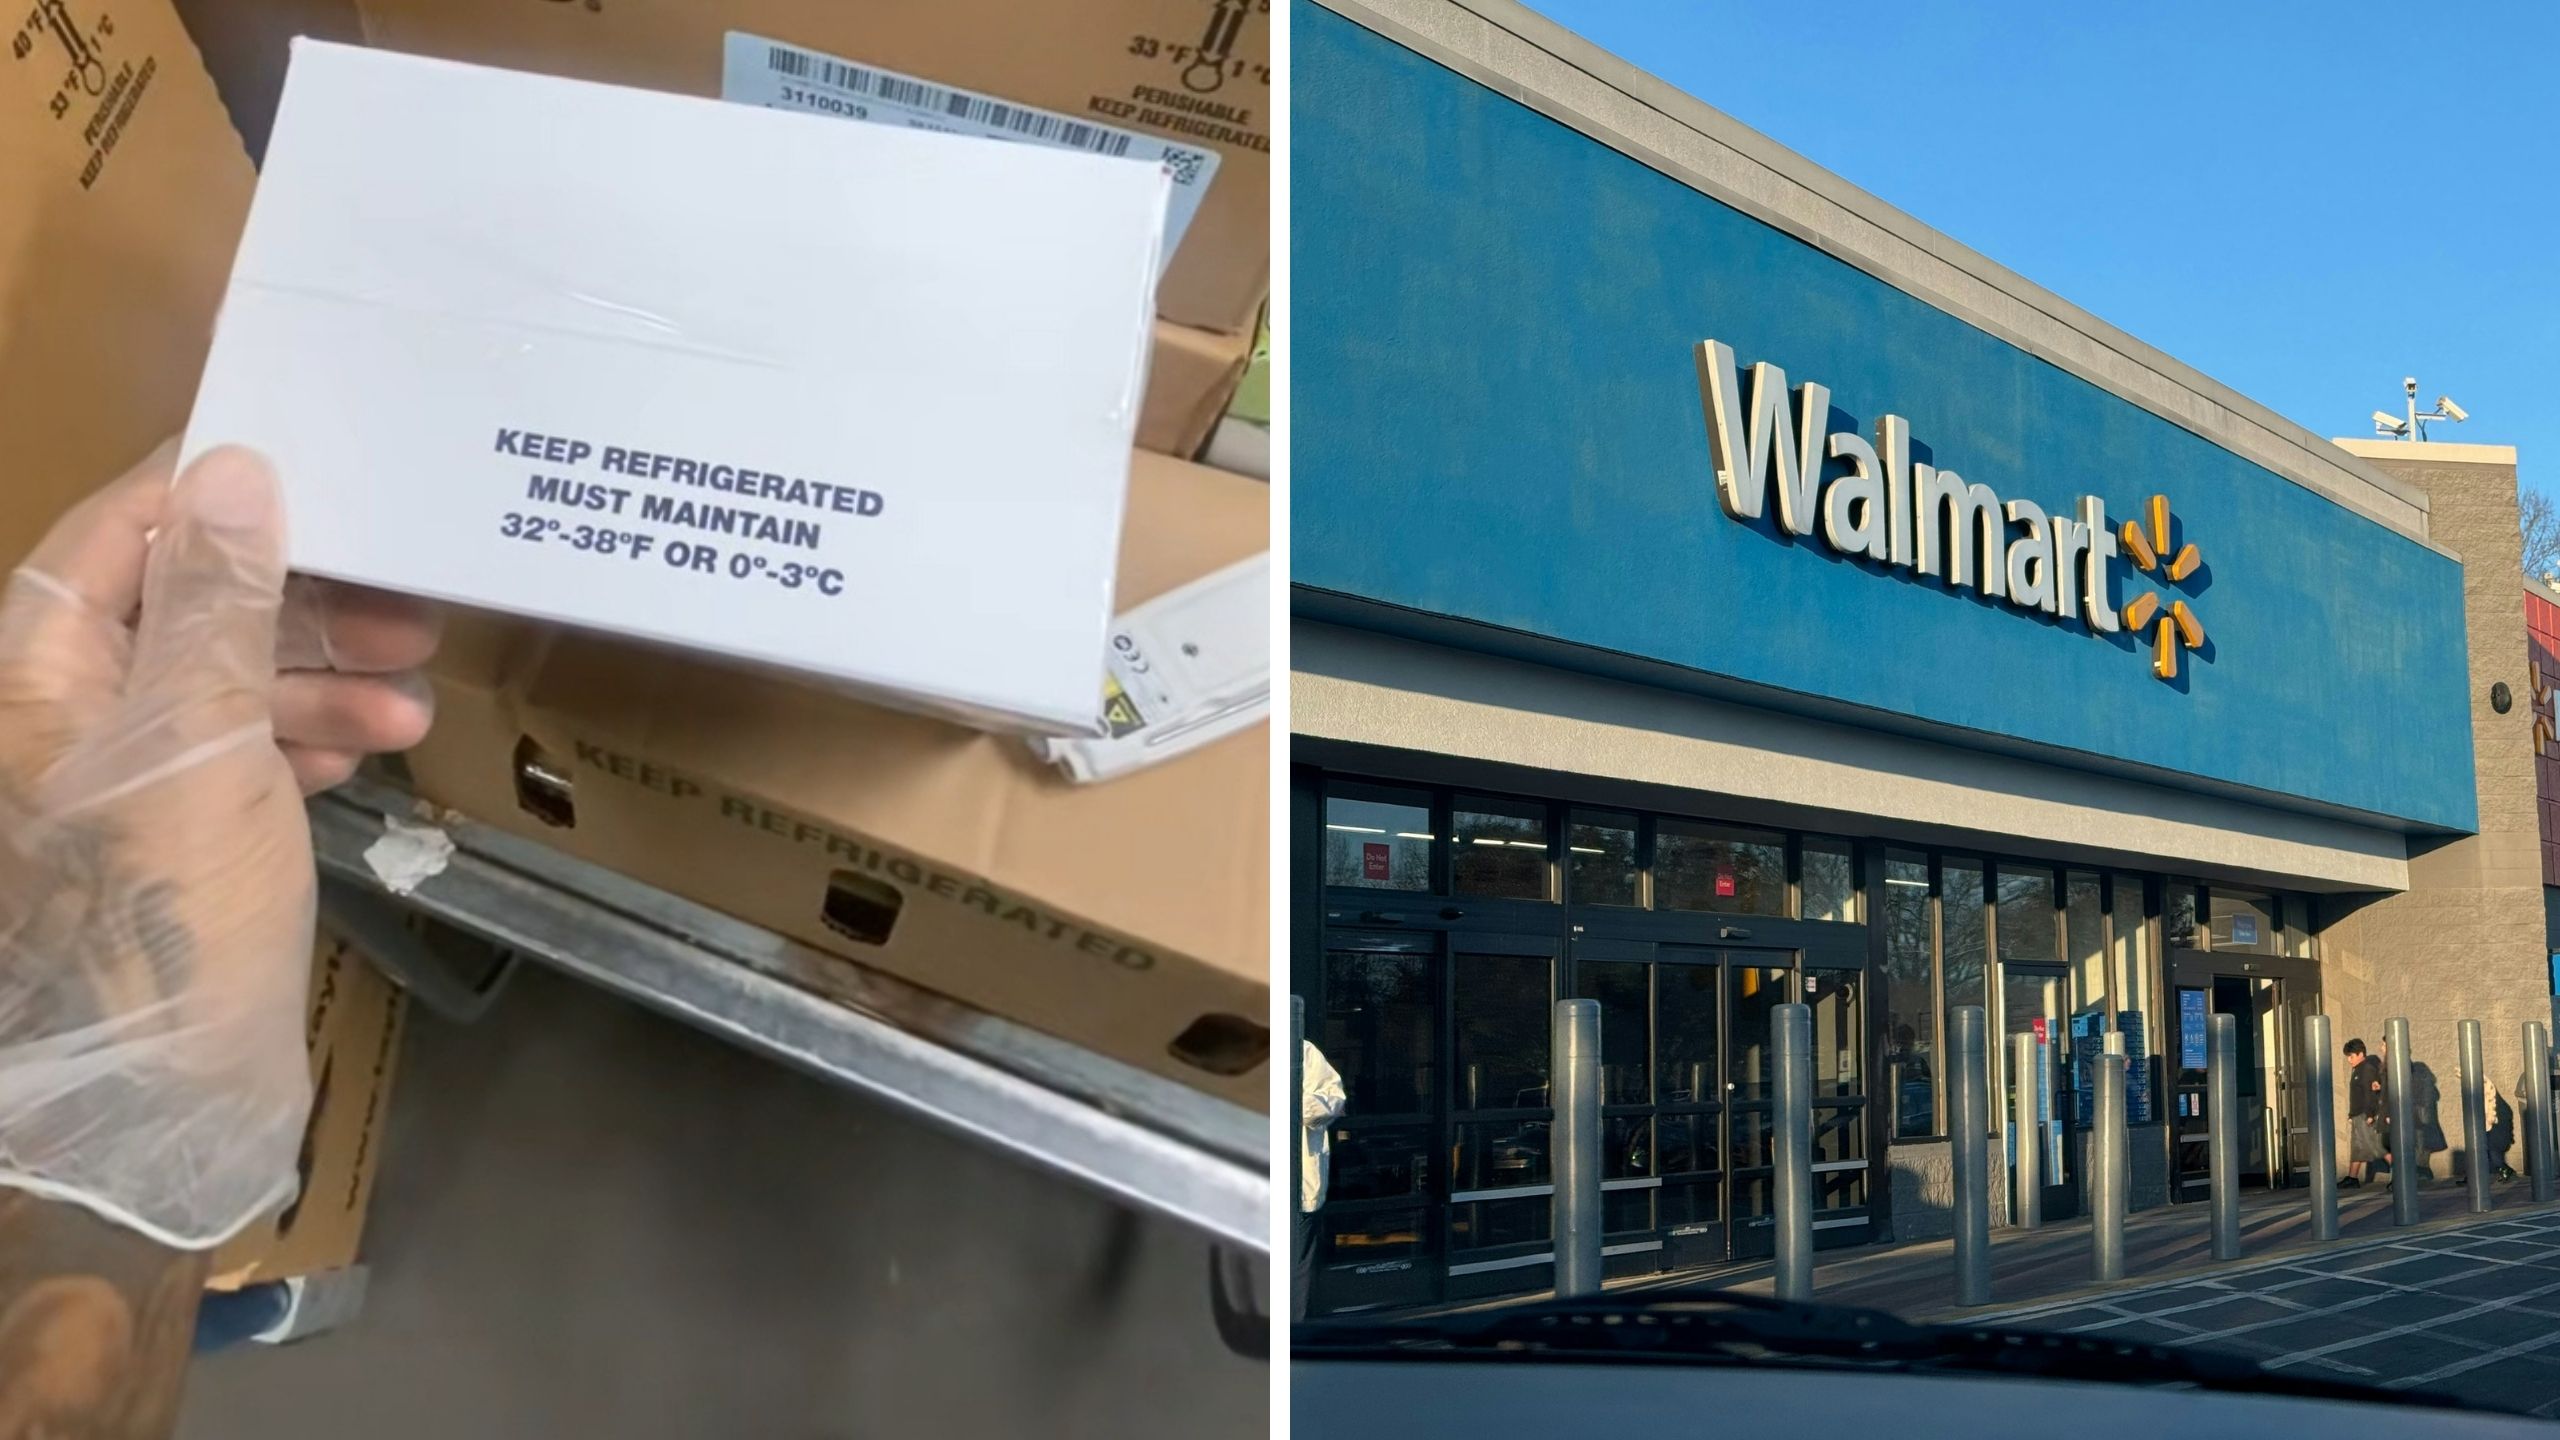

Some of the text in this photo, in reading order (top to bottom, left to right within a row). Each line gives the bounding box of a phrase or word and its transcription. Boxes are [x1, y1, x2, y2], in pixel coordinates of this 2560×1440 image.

[1127, 36, 1160, 58] 33
[1231, 60, 1245, 78] 1
[780, 86, 868, 119] 3110039
[1132, 85, 1252, 125] PERISHABLE
[1088, 96, 1270, 153] KEEP REFRIGERATE
[495, 428, 885, 518] KEEP REFRIGERATED
[1693, 338, 2119, 633] Walmart
[527, 475, 821, 549] MUST MAINTAIN
[664, 541, 718, 573] OR
[575, 739, 1157, 972] KEEP REFRIGERATED
[1368, 861, 1385, 871] Enter
